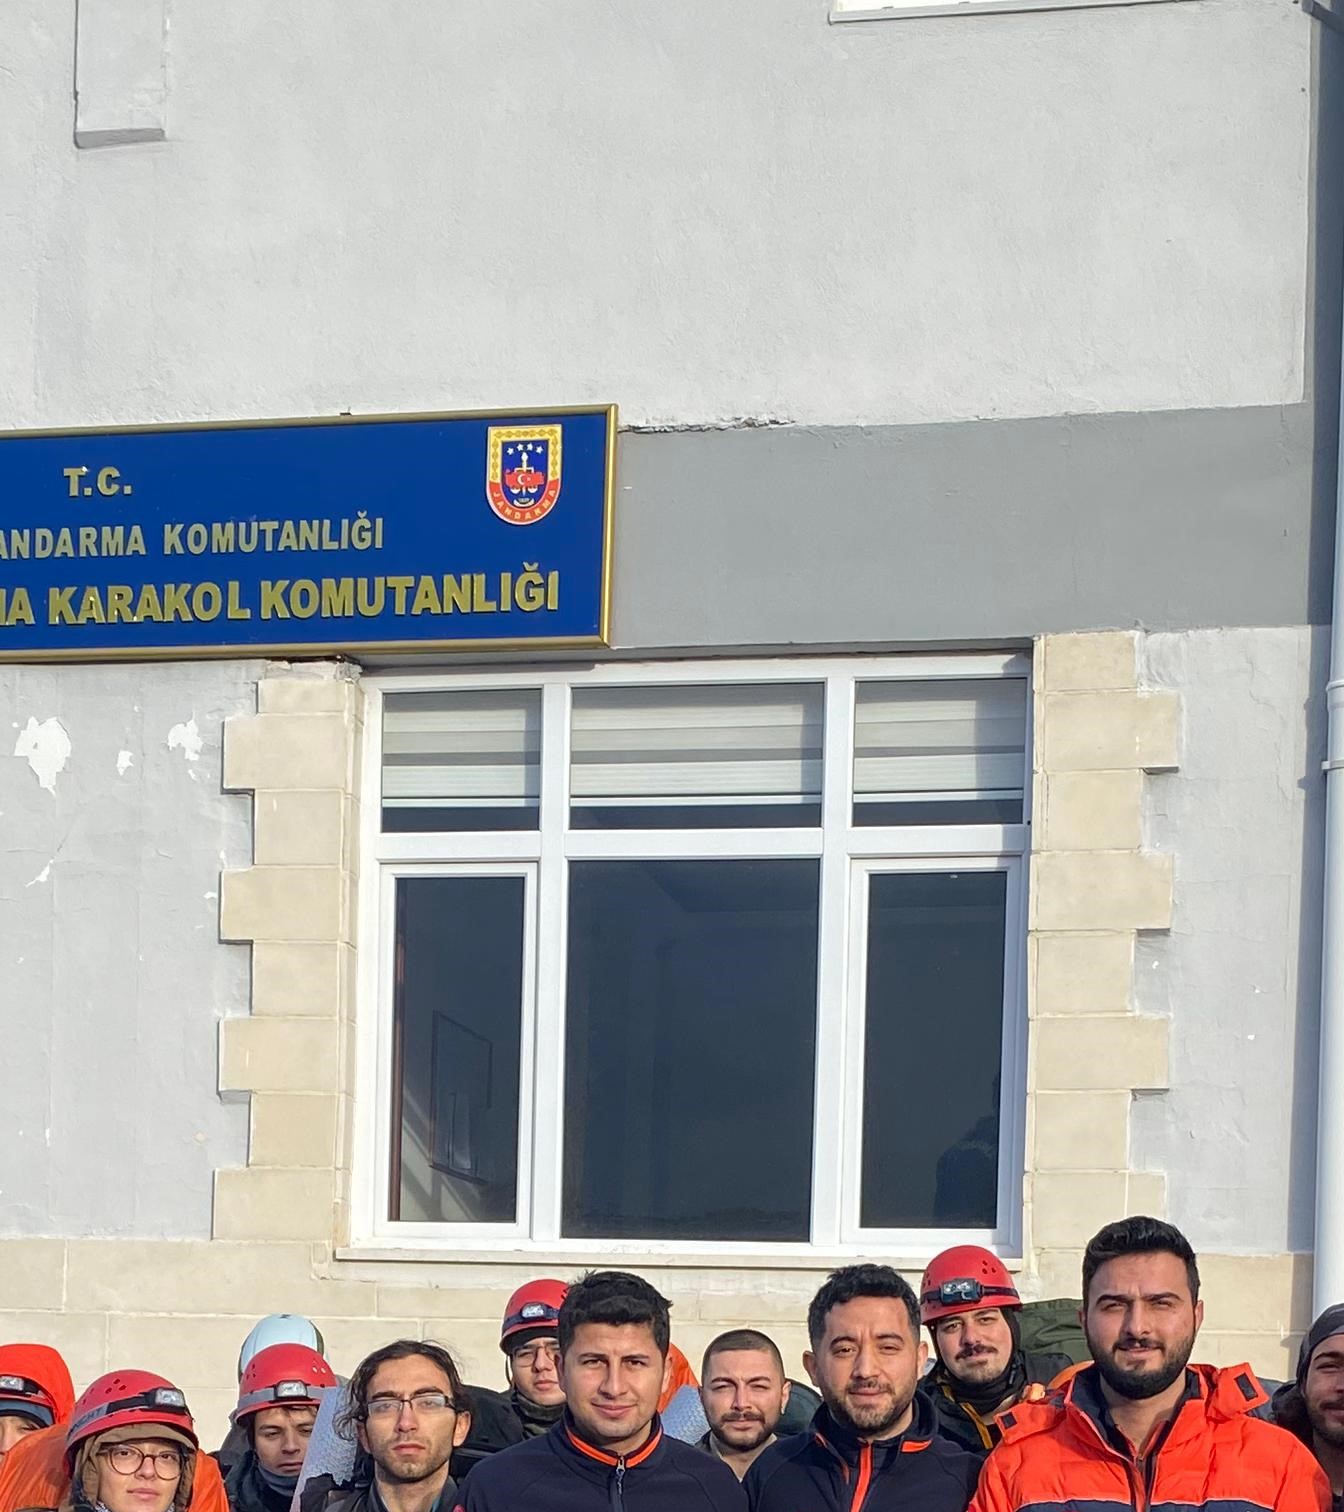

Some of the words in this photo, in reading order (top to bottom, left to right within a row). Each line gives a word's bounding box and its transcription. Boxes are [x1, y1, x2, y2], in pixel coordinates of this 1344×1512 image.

[64, 466, 133, 497] T.C.
[164, 510, 384, 555] KOMUTANLIĞI
[48, 581, 251, 627] KARAKOL
[261, 561, 559, 621] KOMUTANLIĞI
